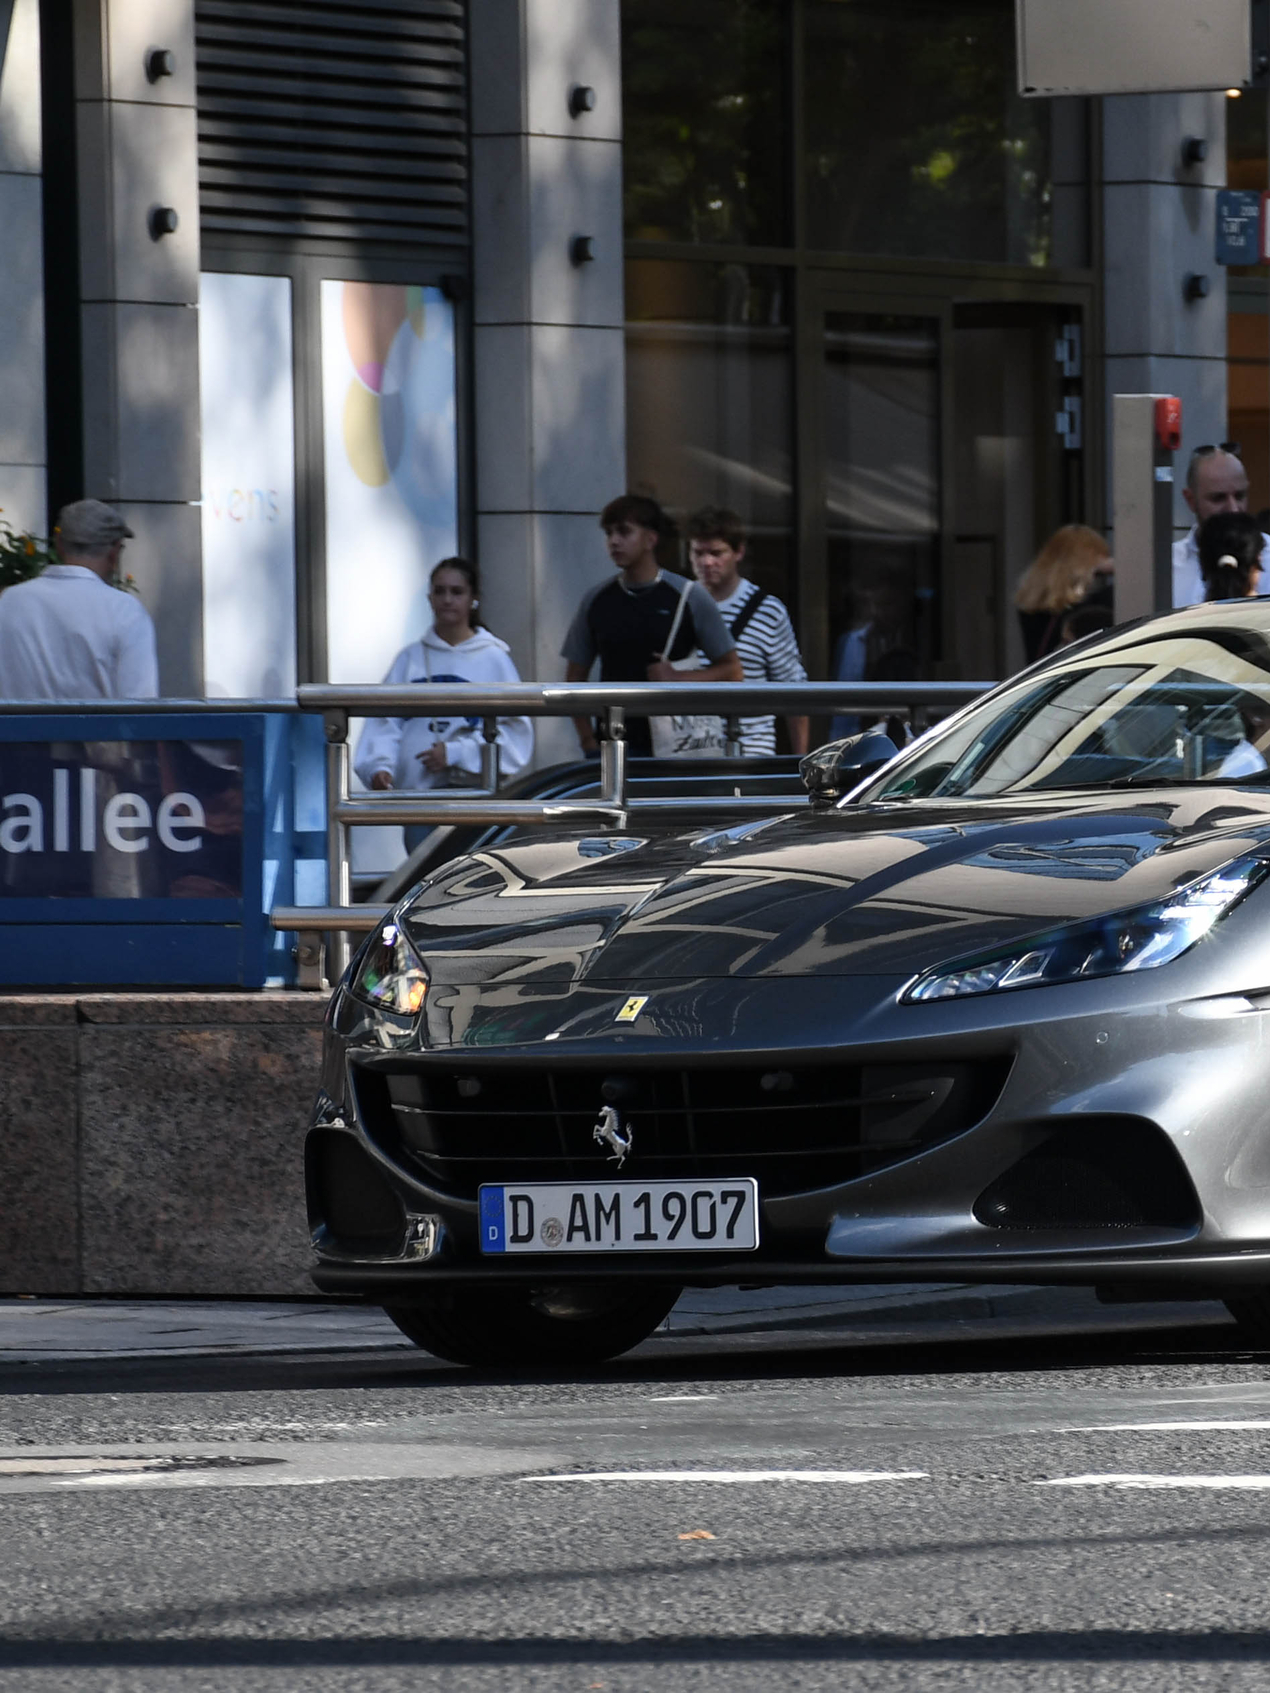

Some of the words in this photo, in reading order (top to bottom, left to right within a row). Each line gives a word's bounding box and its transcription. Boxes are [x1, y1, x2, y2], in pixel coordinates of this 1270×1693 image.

[0, 768, 207, 854] allee
[488, 1226, 498, 1241] D
[509, 1194, 535, 1244] D
[566, 1192, 621, 1243] AM
[633, 1190, 747, 1242] 1907
